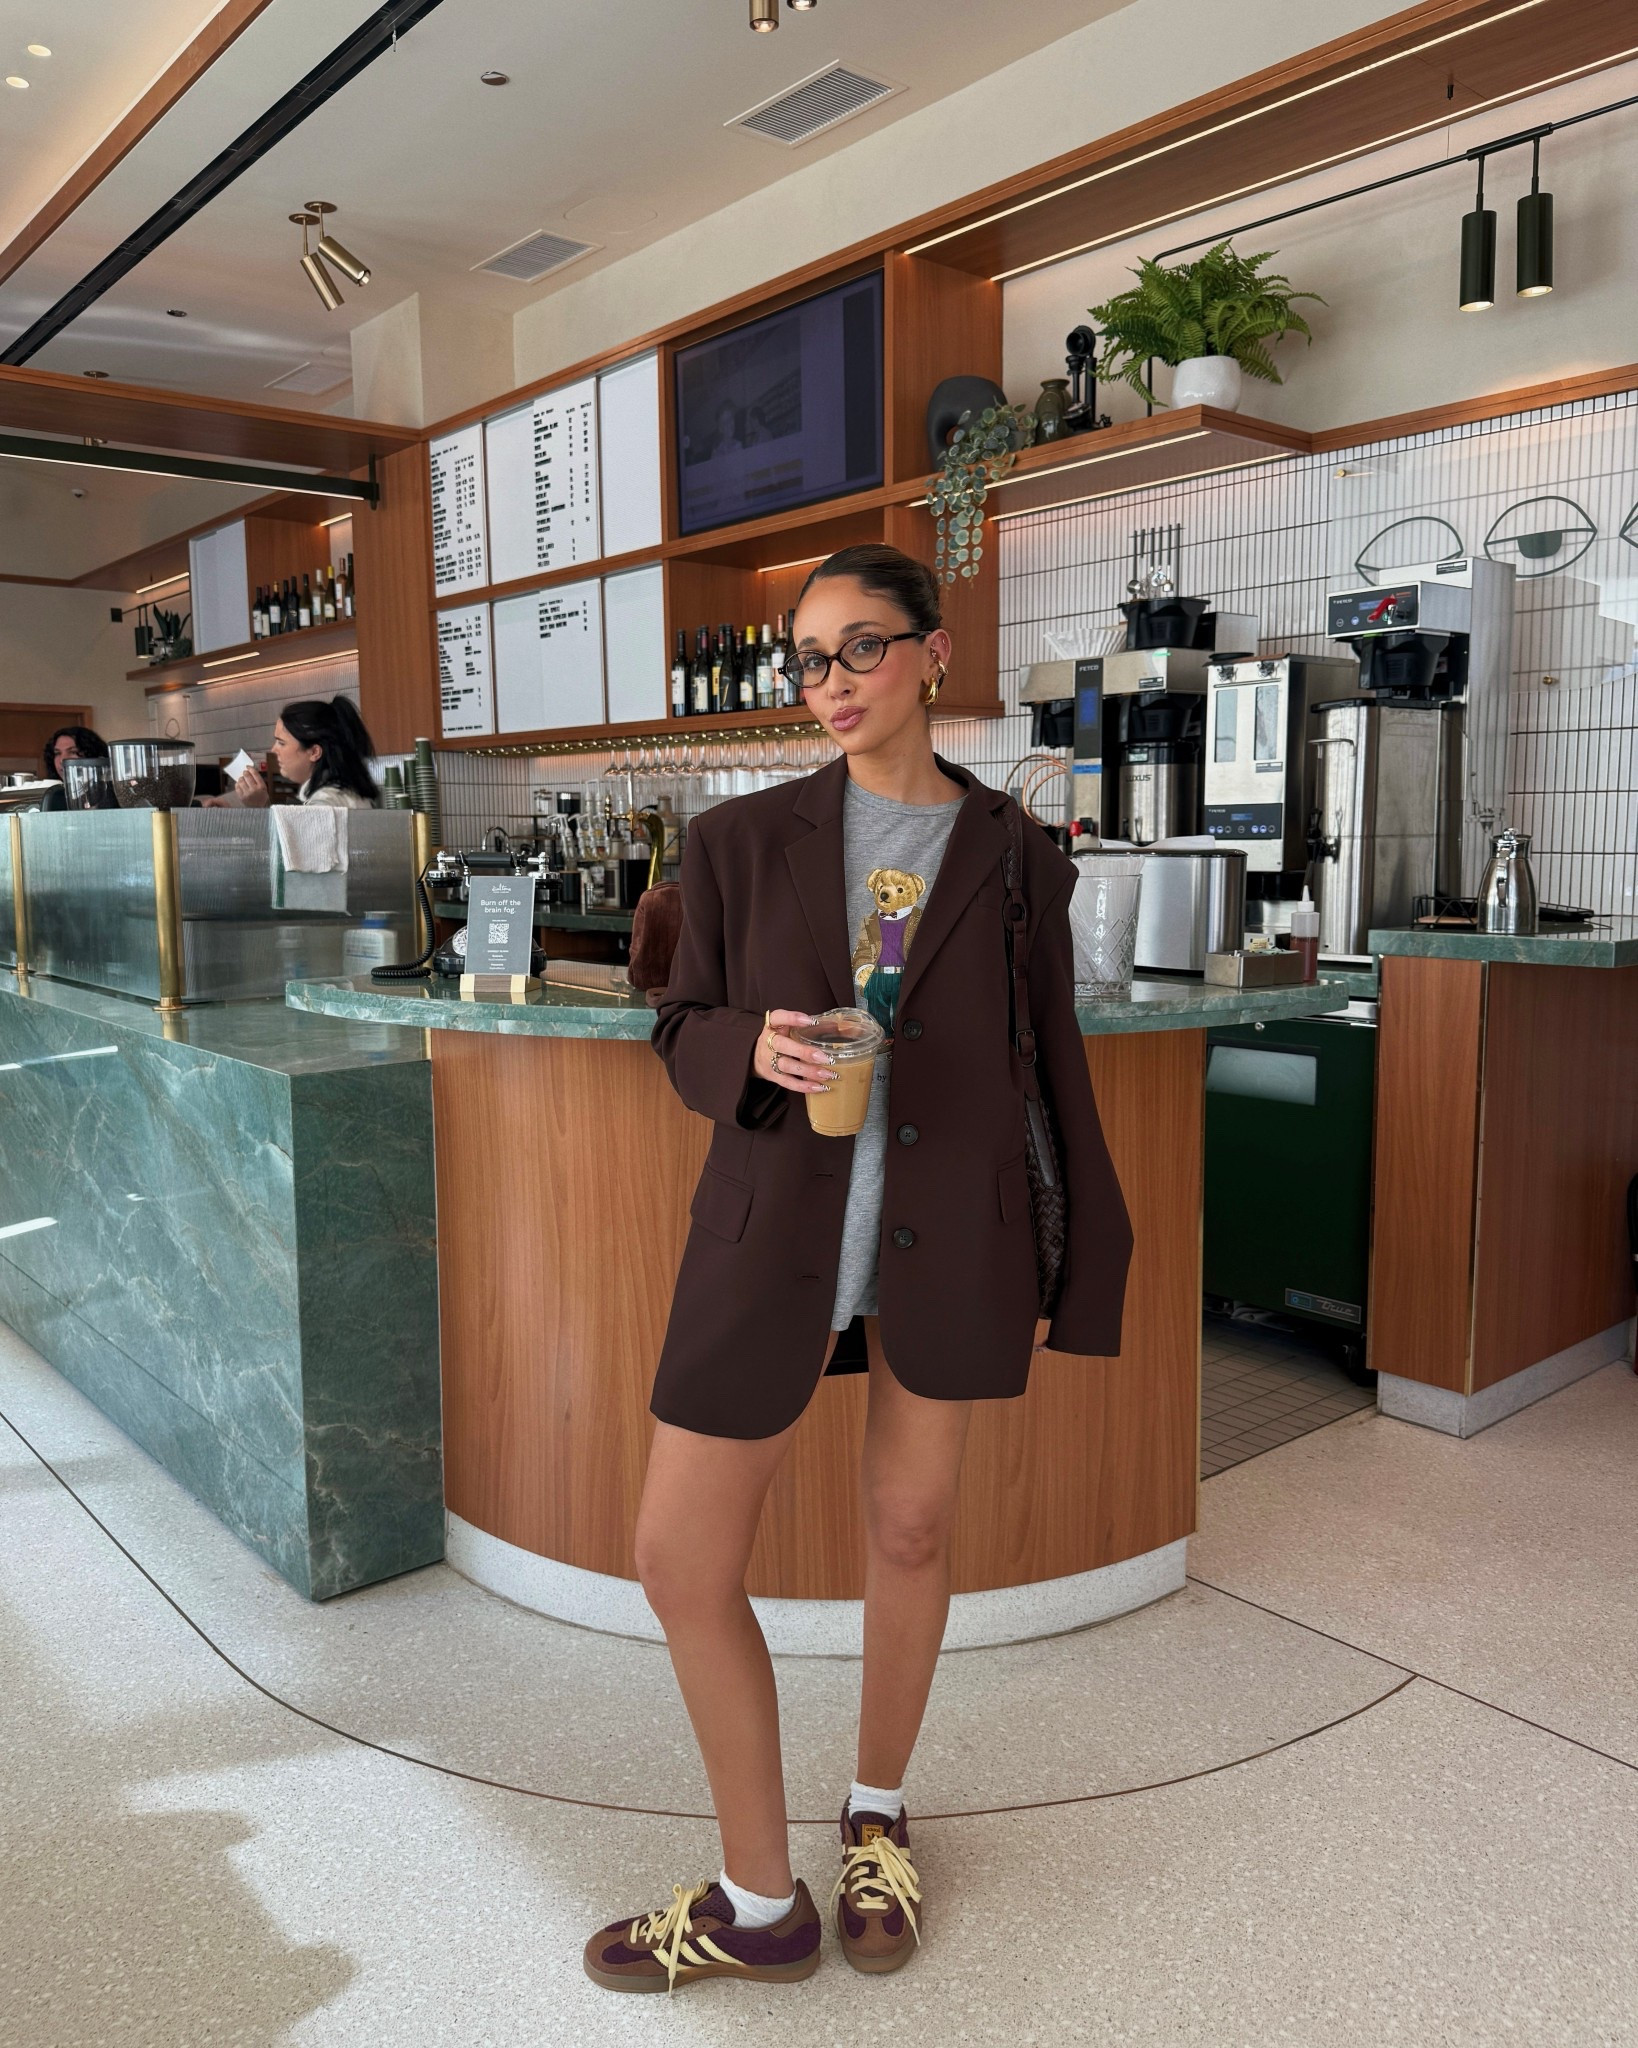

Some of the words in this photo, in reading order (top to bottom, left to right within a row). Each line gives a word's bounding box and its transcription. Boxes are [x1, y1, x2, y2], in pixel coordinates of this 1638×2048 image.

[1079, 664, 1099, 672] FETCO
[1125, 774, 1152, 782] LUXUS
[503, 907, 515, 915] fog.
[877, 1073, 887, 1083] by
